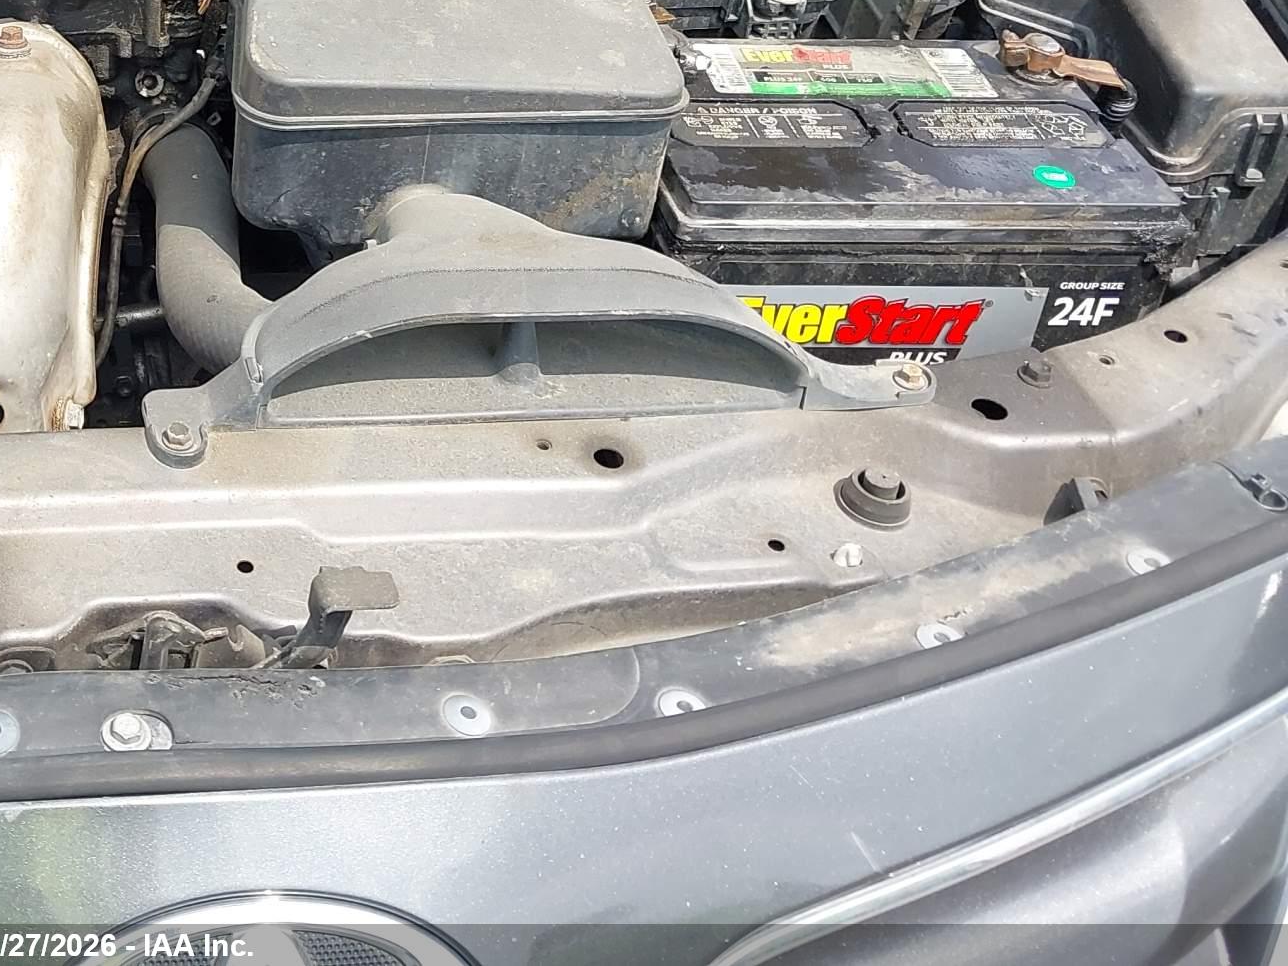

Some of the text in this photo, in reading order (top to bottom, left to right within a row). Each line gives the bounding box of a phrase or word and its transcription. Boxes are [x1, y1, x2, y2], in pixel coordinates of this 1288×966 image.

[1059, 281, 1126, 291] GROUP SIZE
[736, 294, 986, 345] verStart
[1047, 296, 1121, 327] 24F
